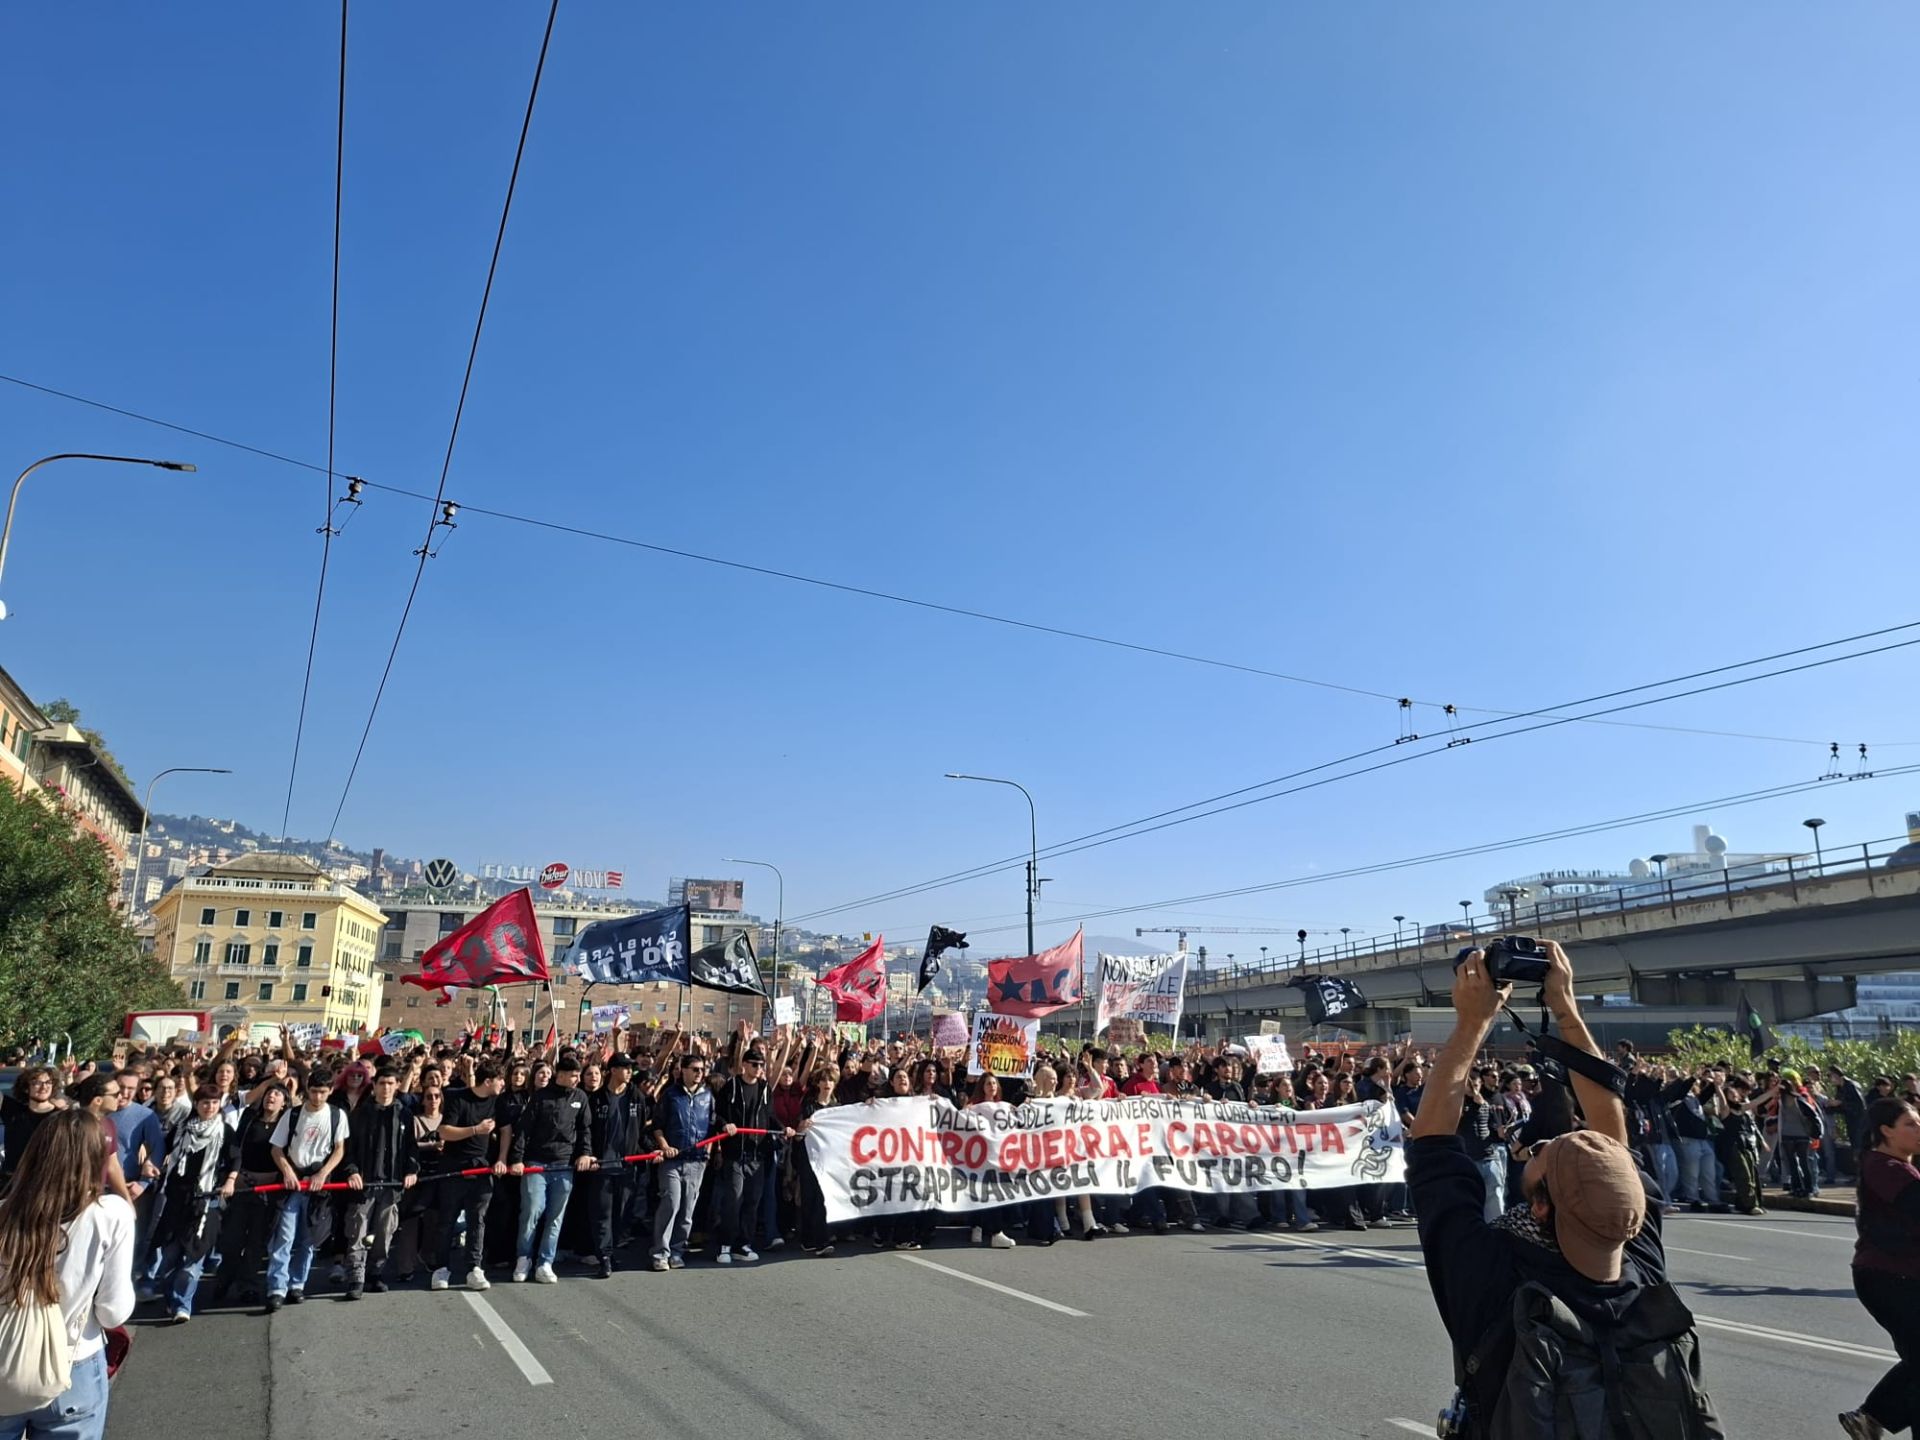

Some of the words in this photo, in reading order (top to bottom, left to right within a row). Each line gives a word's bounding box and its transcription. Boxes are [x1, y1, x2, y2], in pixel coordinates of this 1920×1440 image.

[574, 870, 607, 888] NOVI
[1102, 957, 1128, 982] NON
[1132, 994, 1178, 1013] GUERRE
[979, 1016, 1000, 1030] NON
[977, 1031, 1021, 1046] REPRESSION
[976, 1054, 1035, 1073] REVOLUTION
[930, 1103, 986, 1132] DALLE
[1065, 1102, 1095, 1124] ALLE
[1193, 1103, 1207, 1120] AI
[850, 1126, 988, 1169] CONTRO
[999, 1123, 1133, 1172] GUERRA
[1137, 1123, 1151, 1155] E
[1166, 1121, 1345, 1158] CAROVITA
[850, 1161, 1099, 1208] STRAPPIAMOGLI
[1116, 1159, 1137, 1188] IL
[1152, 1149, 1308, 1188] FUTURO!
